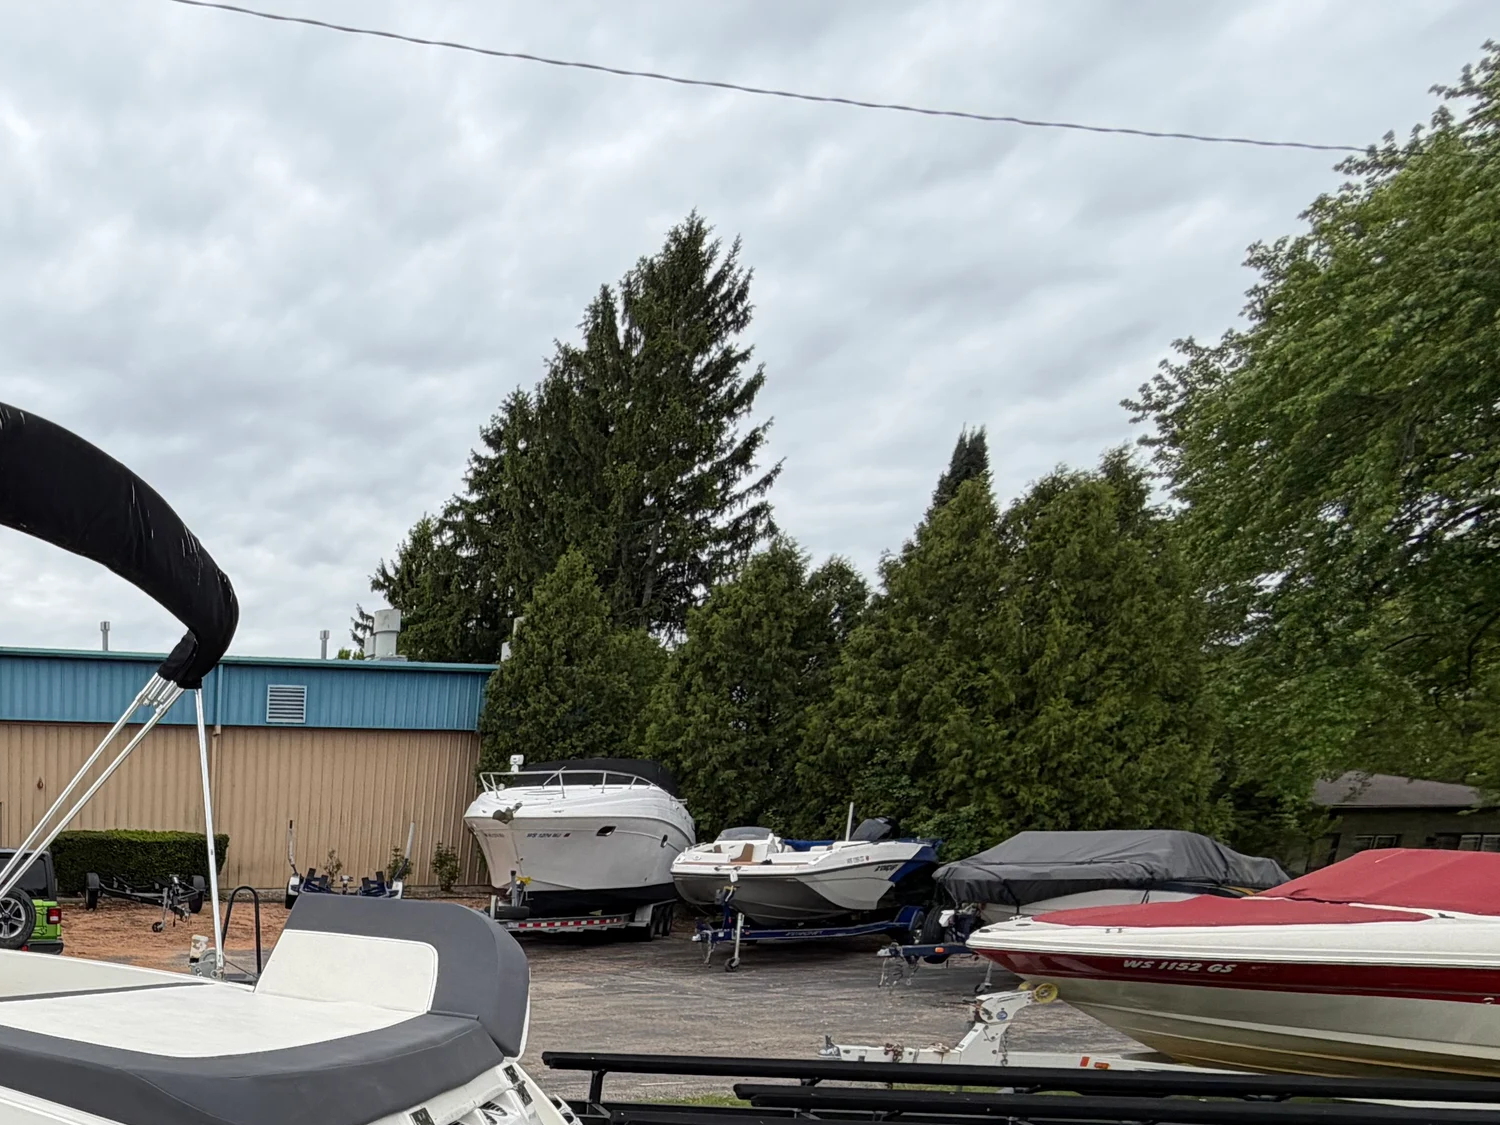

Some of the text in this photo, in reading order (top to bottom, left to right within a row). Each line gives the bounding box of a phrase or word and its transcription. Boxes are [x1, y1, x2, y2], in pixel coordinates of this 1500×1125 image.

[1122, 959, 1238, 974] WS 1152 GS
